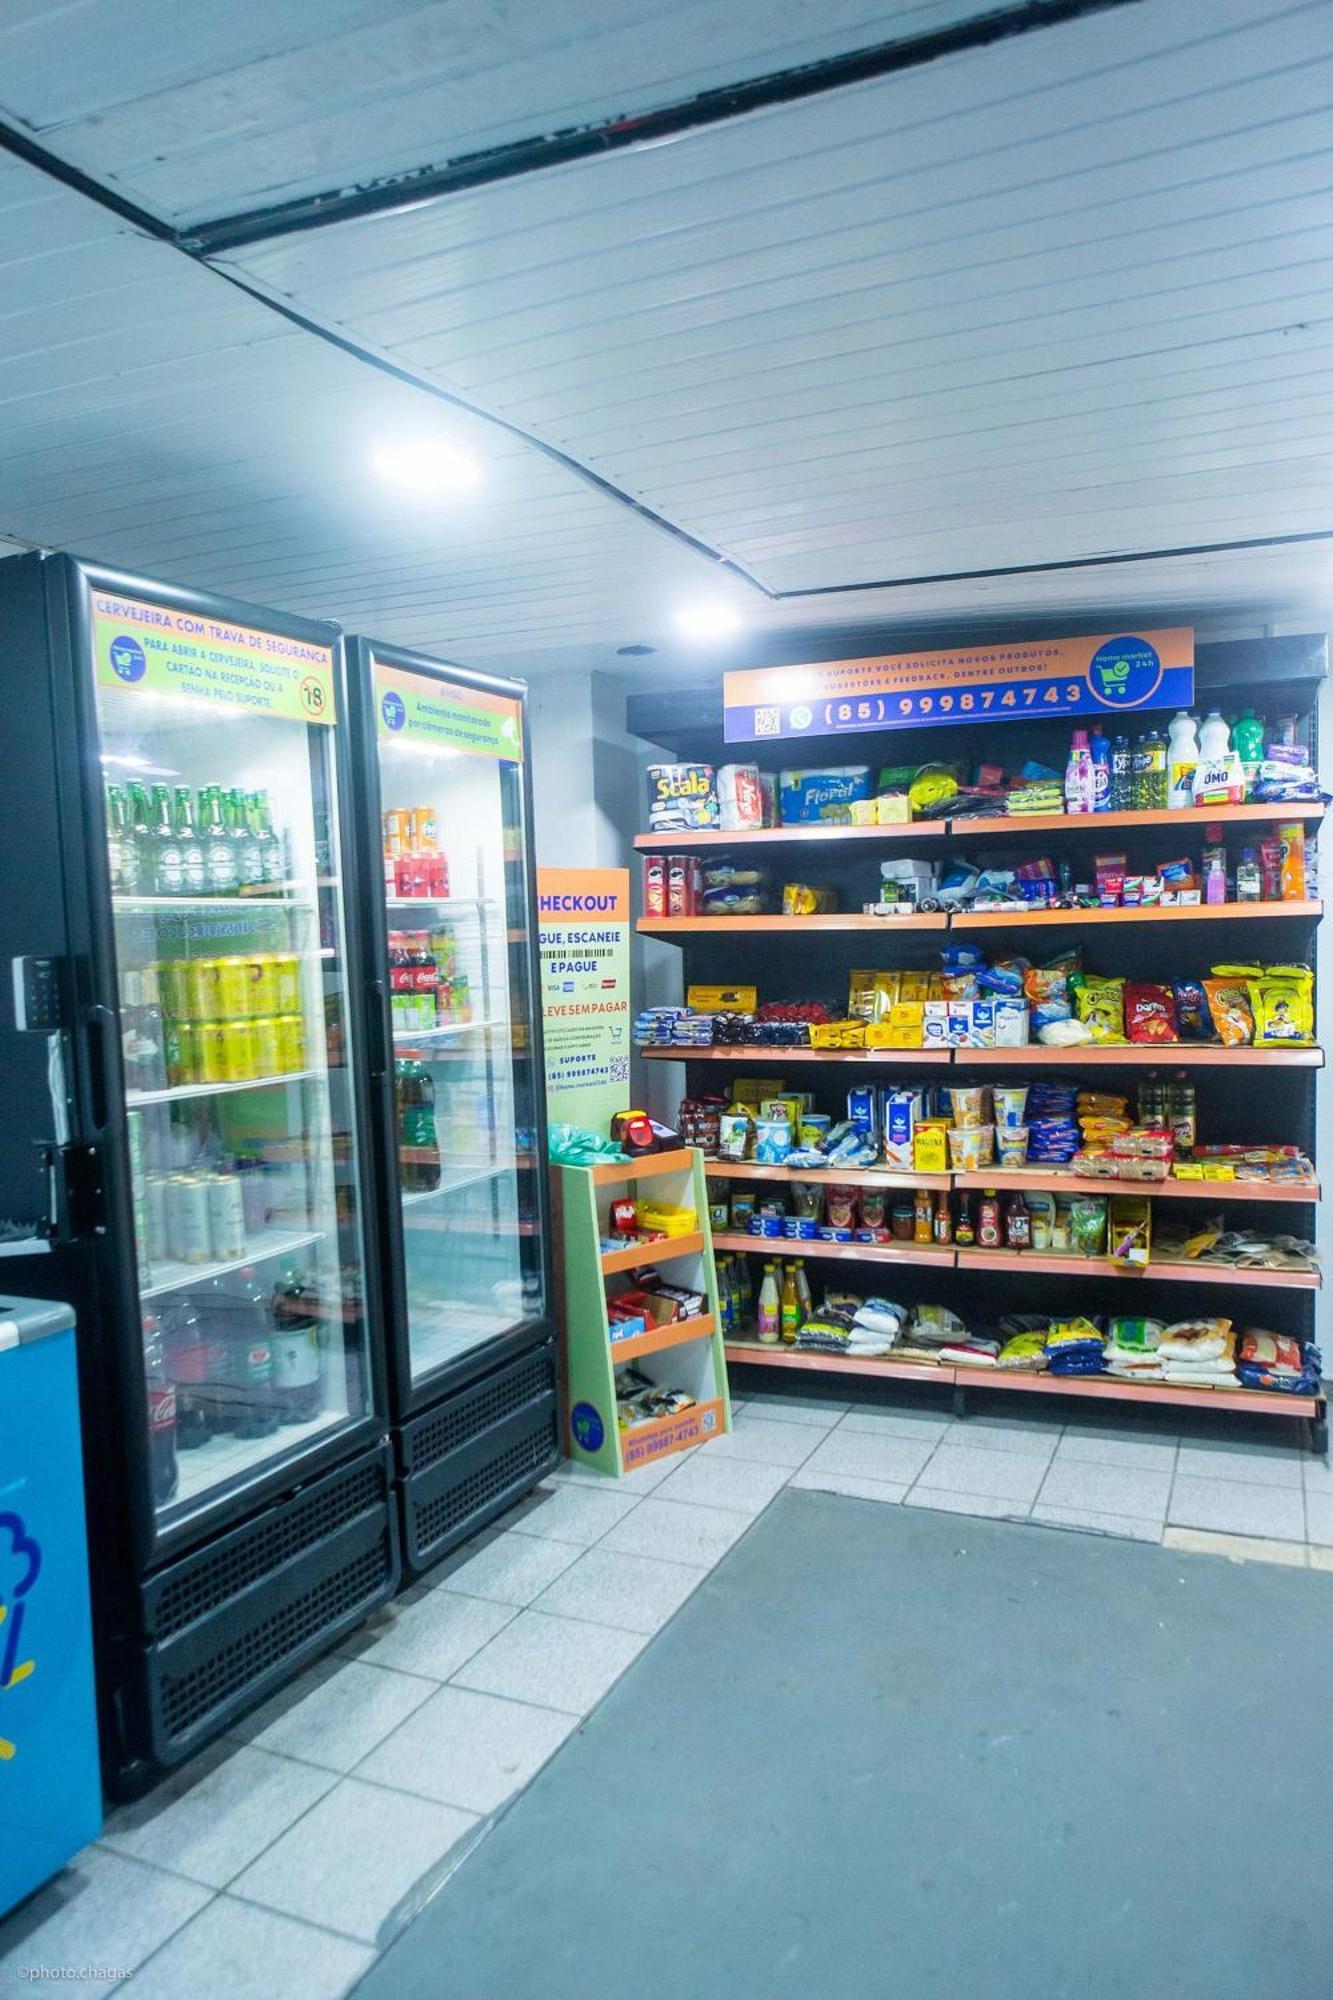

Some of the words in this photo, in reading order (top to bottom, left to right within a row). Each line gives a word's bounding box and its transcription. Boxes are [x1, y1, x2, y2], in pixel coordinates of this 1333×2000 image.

[97, 599, 172, 628] CERVEJEIRA
[176, 618, 205, 635] COM
[208, 625, 245, 645] TRAVA
[249, 634, 262, 650] DE
[143, 638, 168, 653] PARA
[172, 643, 197, 658] ABRIR
[200, 650, 206, 659] A
[205, 668, 219, 681] NA
[827, 665, 872, 678] SUPORTE
[906, 658, 954, 669] SOLICITA
[825, 700, 885, 725] (85)
[899, 684, 1081, 716] 999874743
[1204, 771, 1228, 784] OMO
[656, 771, 711, 800] Scala
[540, 895, 618, 911] HECKOUT
[567, 931, 621, 943] ESCANEIE
[551, 962, 557, 973] E
[559, 961, 598, 973] PAGUE
[568, 1003, 590, 1015] SEM
[591, 1001, 628, 1014] PAGAR
[559, 1053, 597, 1065] SUPORTE
